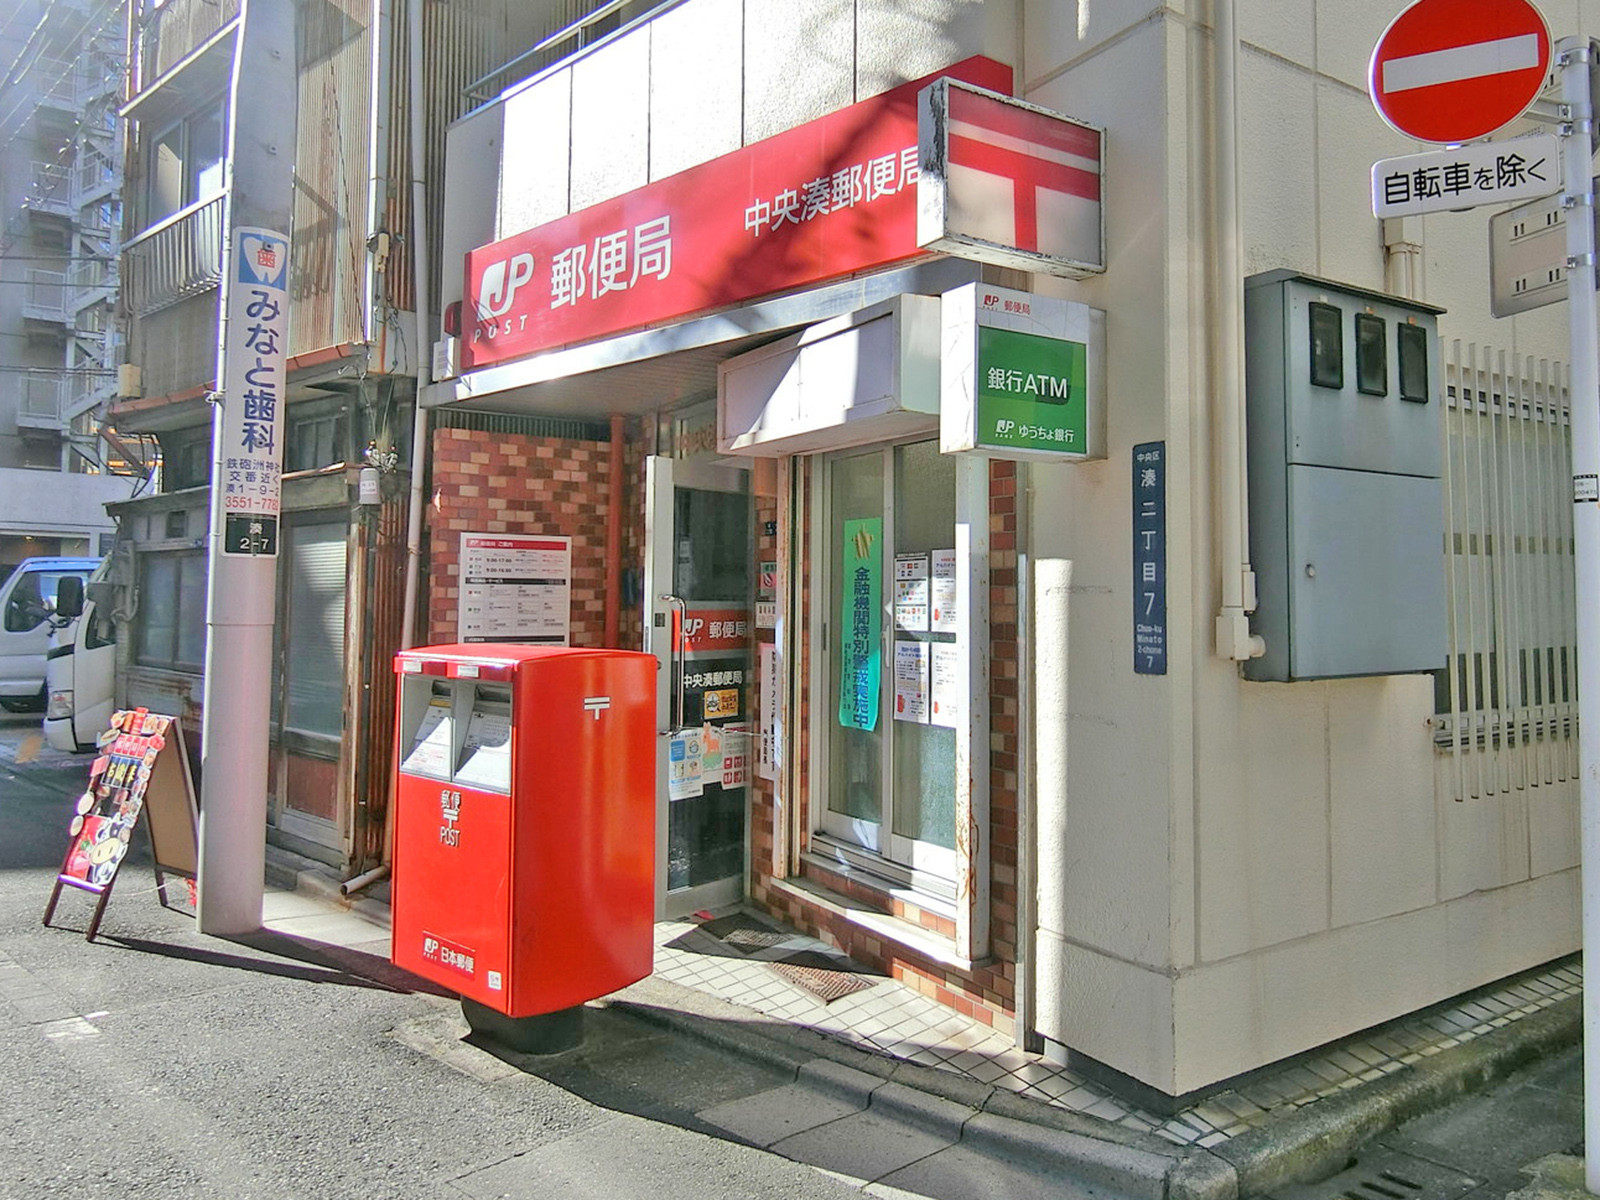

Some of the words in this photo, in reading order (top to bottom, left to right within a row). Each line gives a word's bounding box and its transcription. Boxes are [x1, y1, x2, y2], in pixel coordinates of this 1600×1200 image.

[1384, 152, 1547, 206] 自転車を除く
[744, 145, 919, 238] 中央湊郵便局
[550, 214, 673, 311] 郵便局
[473, 314, 529, 344] POST
[241, 289, 281, 456] みなと歯科
[987, 366, 1068, 399] 銀行ATM
[1018, 424, 1075, 443] ゆうちょ銀行
[1136, 450, 1160, 463] 中央区
[229, 470, 280, 485] 交番近く
[240, 538, 269, 550] 2-7
[709, 620, 747, 639] 郵便局
[1136, 623, 1162, 633] Chuo-ku
[1136, 634, 1162, 644] Minato
[1146, 655, 1153, 668] 7
[683, 670, 743, 689] 中央湊郵便局
[441, 790, 461, 811] 郵便
[440, 826, 461, 848] POST
[441, 946, 475, 974] 日本郵便
